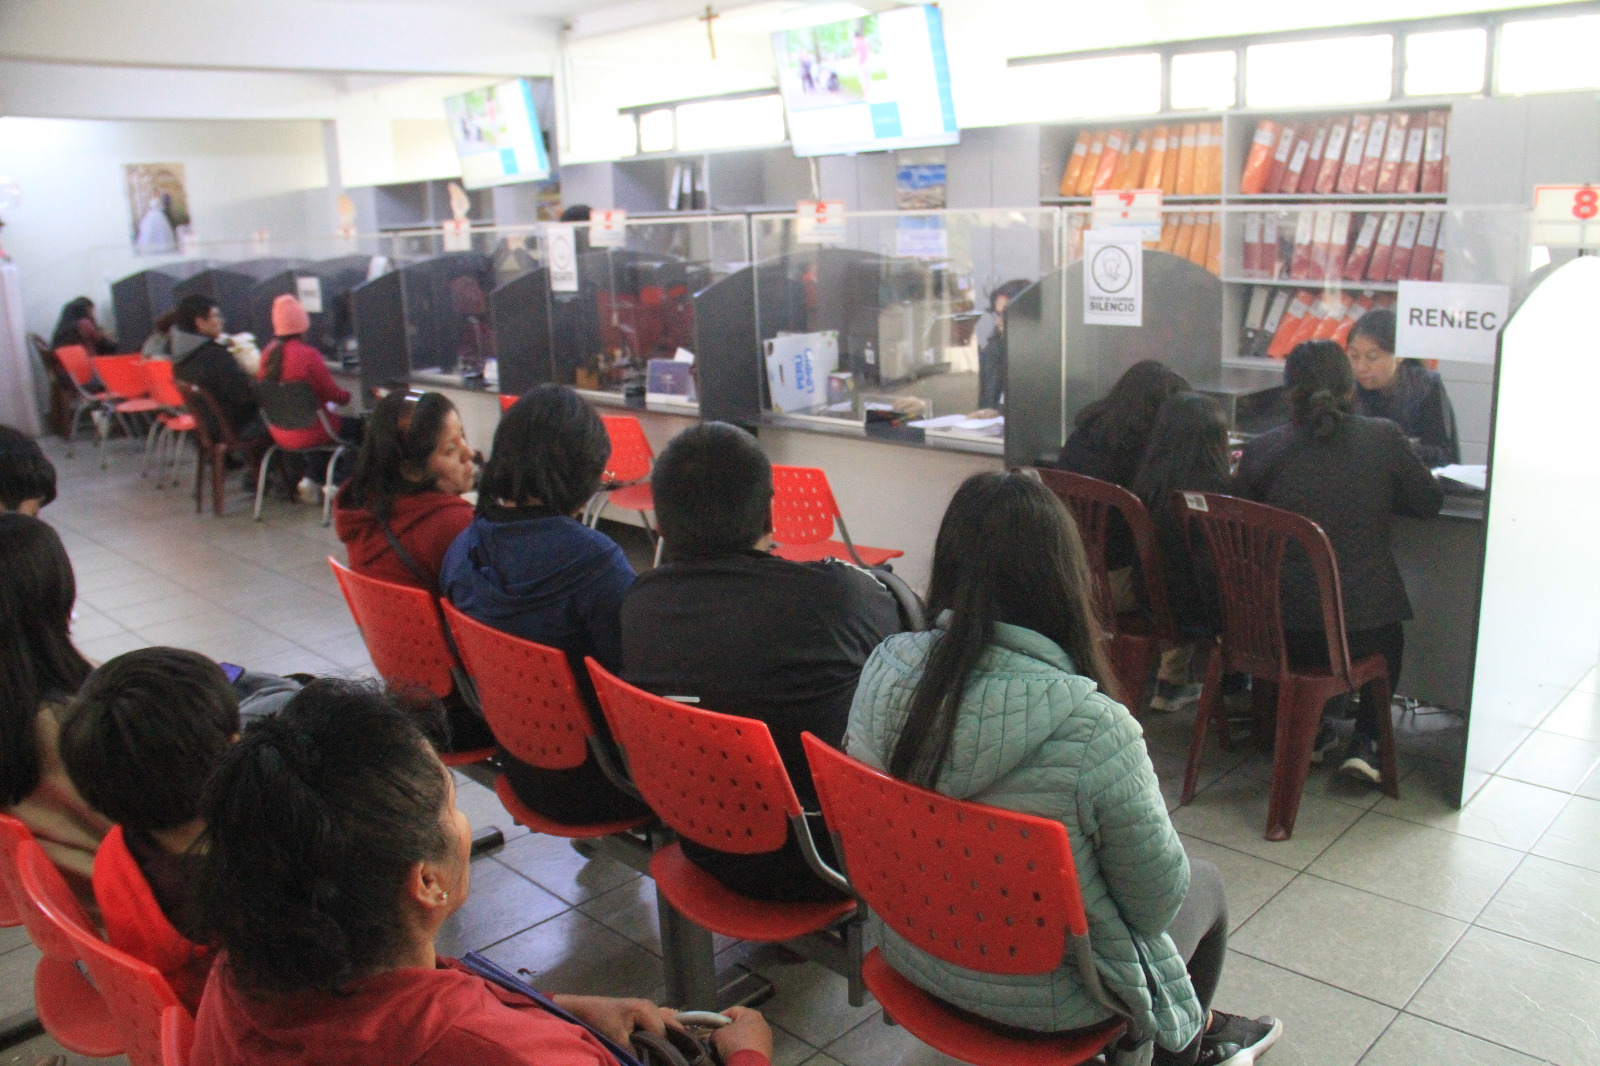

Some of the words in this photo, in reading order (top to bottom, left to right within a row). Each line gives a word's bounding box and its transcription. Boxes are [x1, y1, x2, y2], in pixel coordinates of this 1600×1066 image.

[1572, 190, 1598, 220] 8
[1089, 301, 1135, 312] SILENCIO
[1409, 307, 1497, 331] RENIEC
